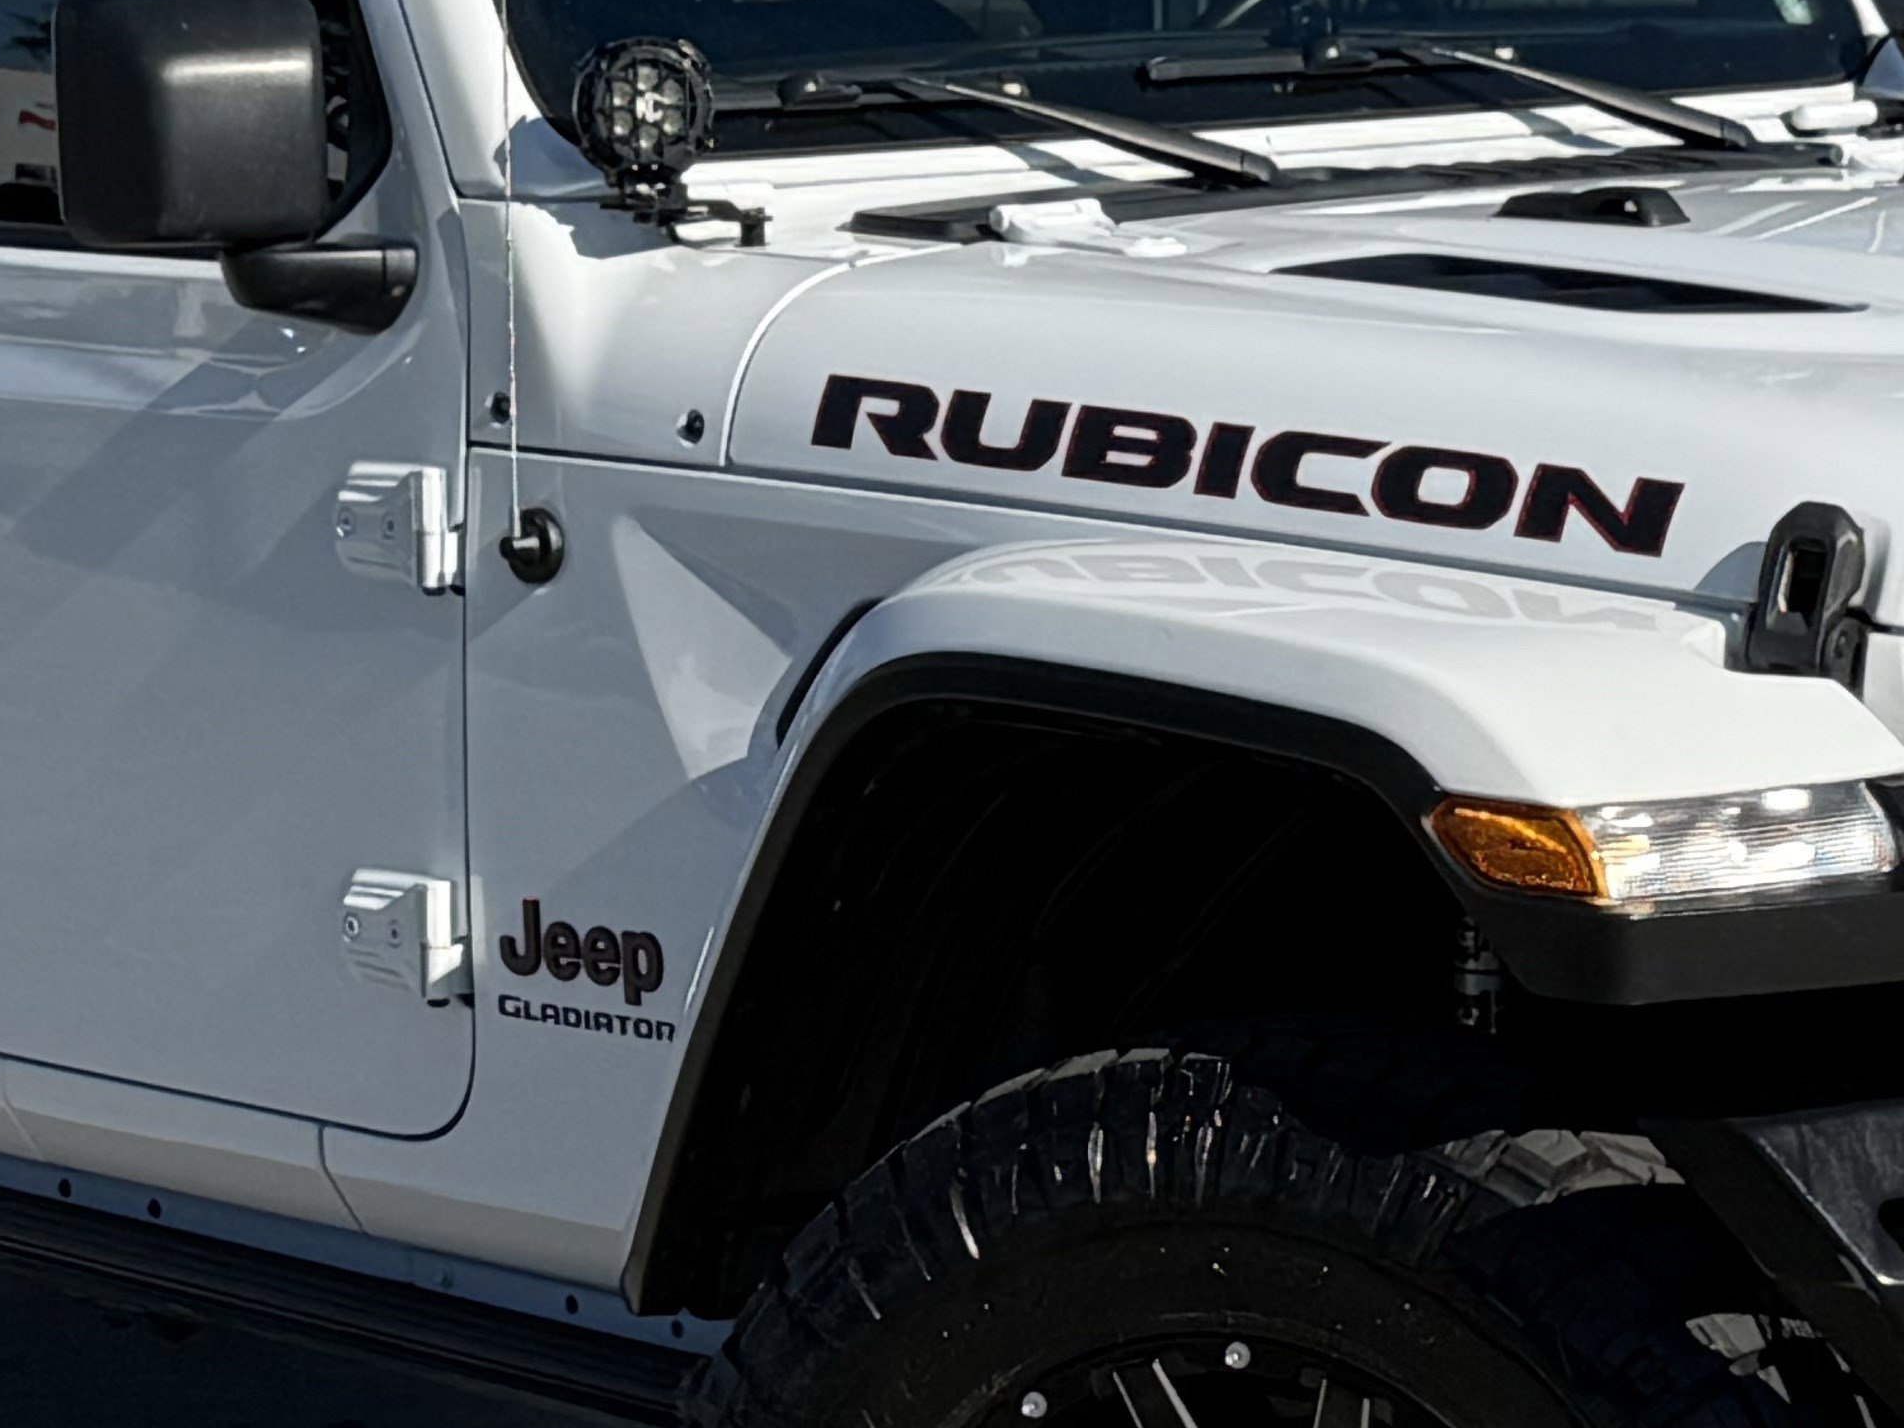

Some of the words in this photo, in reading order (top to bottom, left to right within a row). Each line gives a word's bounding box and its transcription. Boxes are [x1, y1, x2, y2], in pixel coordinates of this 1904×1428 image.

[809, 372, 1687, 558] RUBICON
[499, 896, 664, 1006] Jeep
[498, 994, 676, 1043] GLADIATOR
